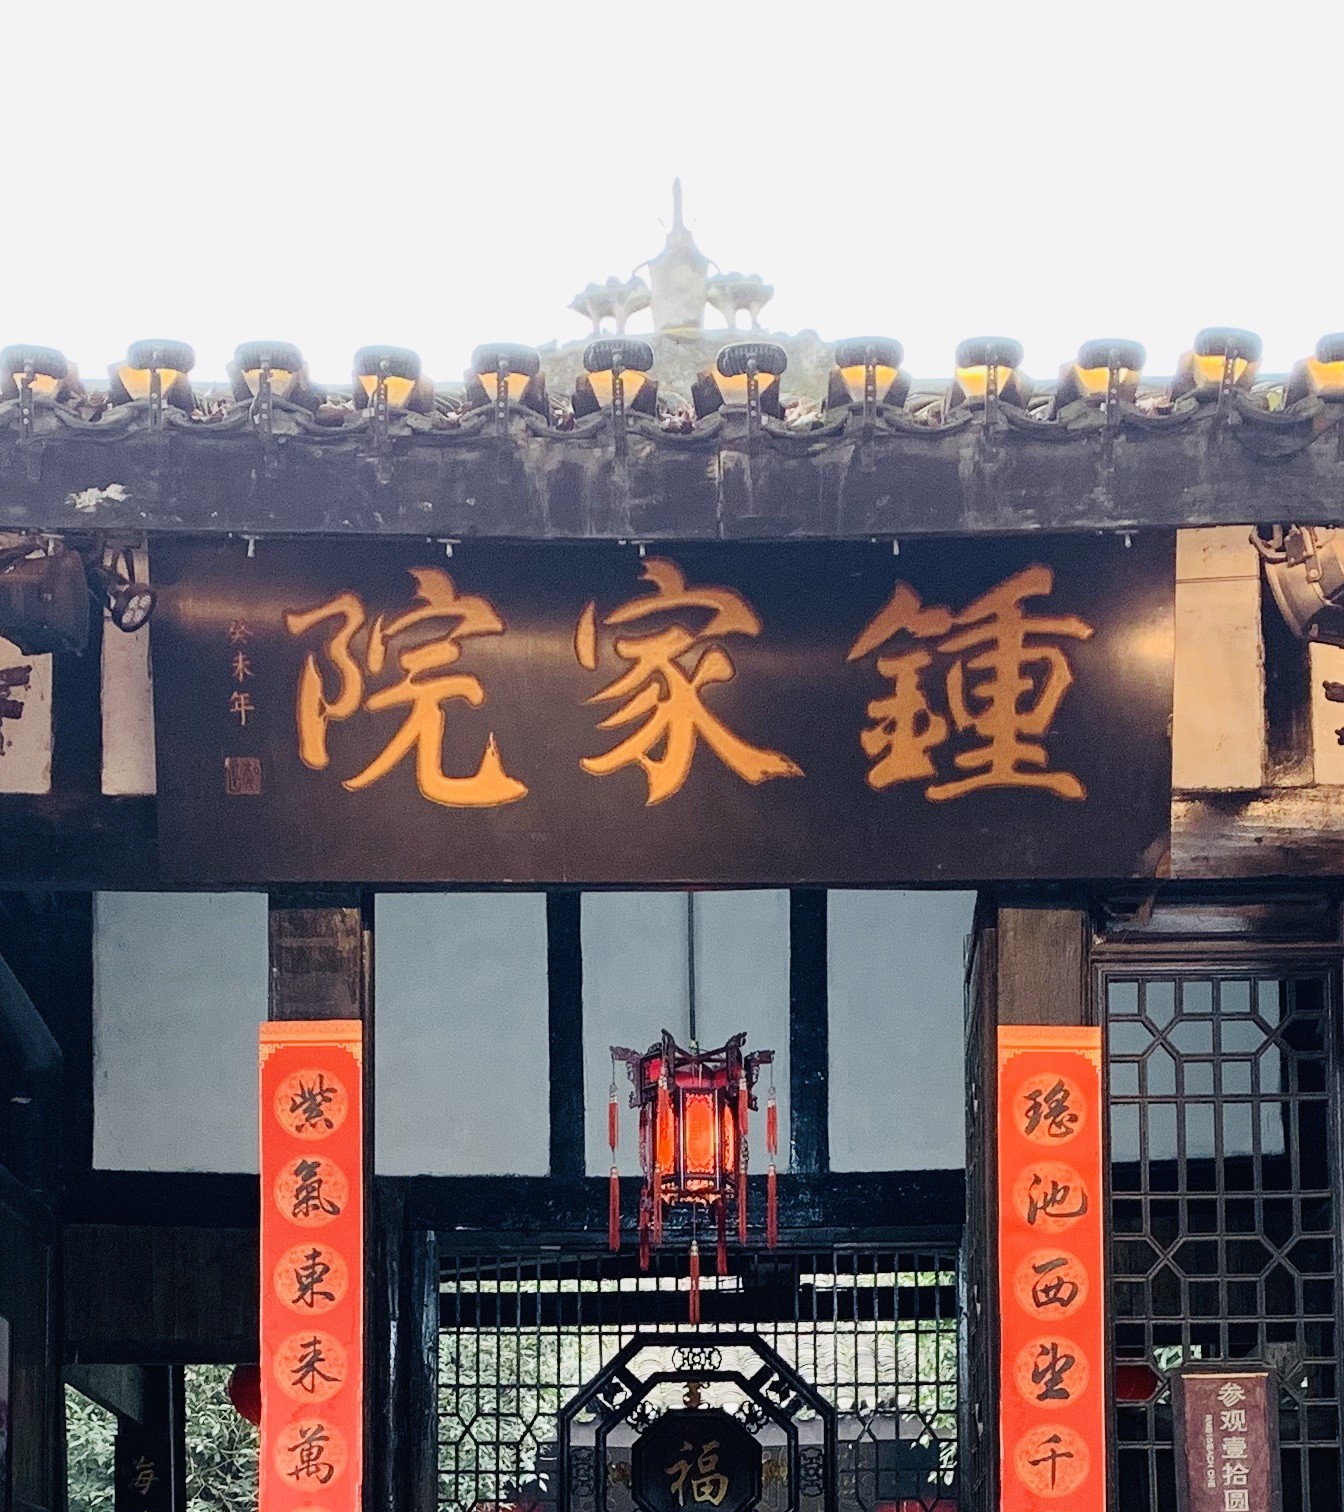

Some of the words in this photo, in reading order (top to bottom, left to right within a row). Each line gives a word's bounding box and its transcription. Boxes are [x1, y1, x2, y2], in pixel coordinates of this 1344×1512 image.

[665, 1439, 730, 1507] 福
[1217, 1382, 1250, 1512] 参观壹拾圆
